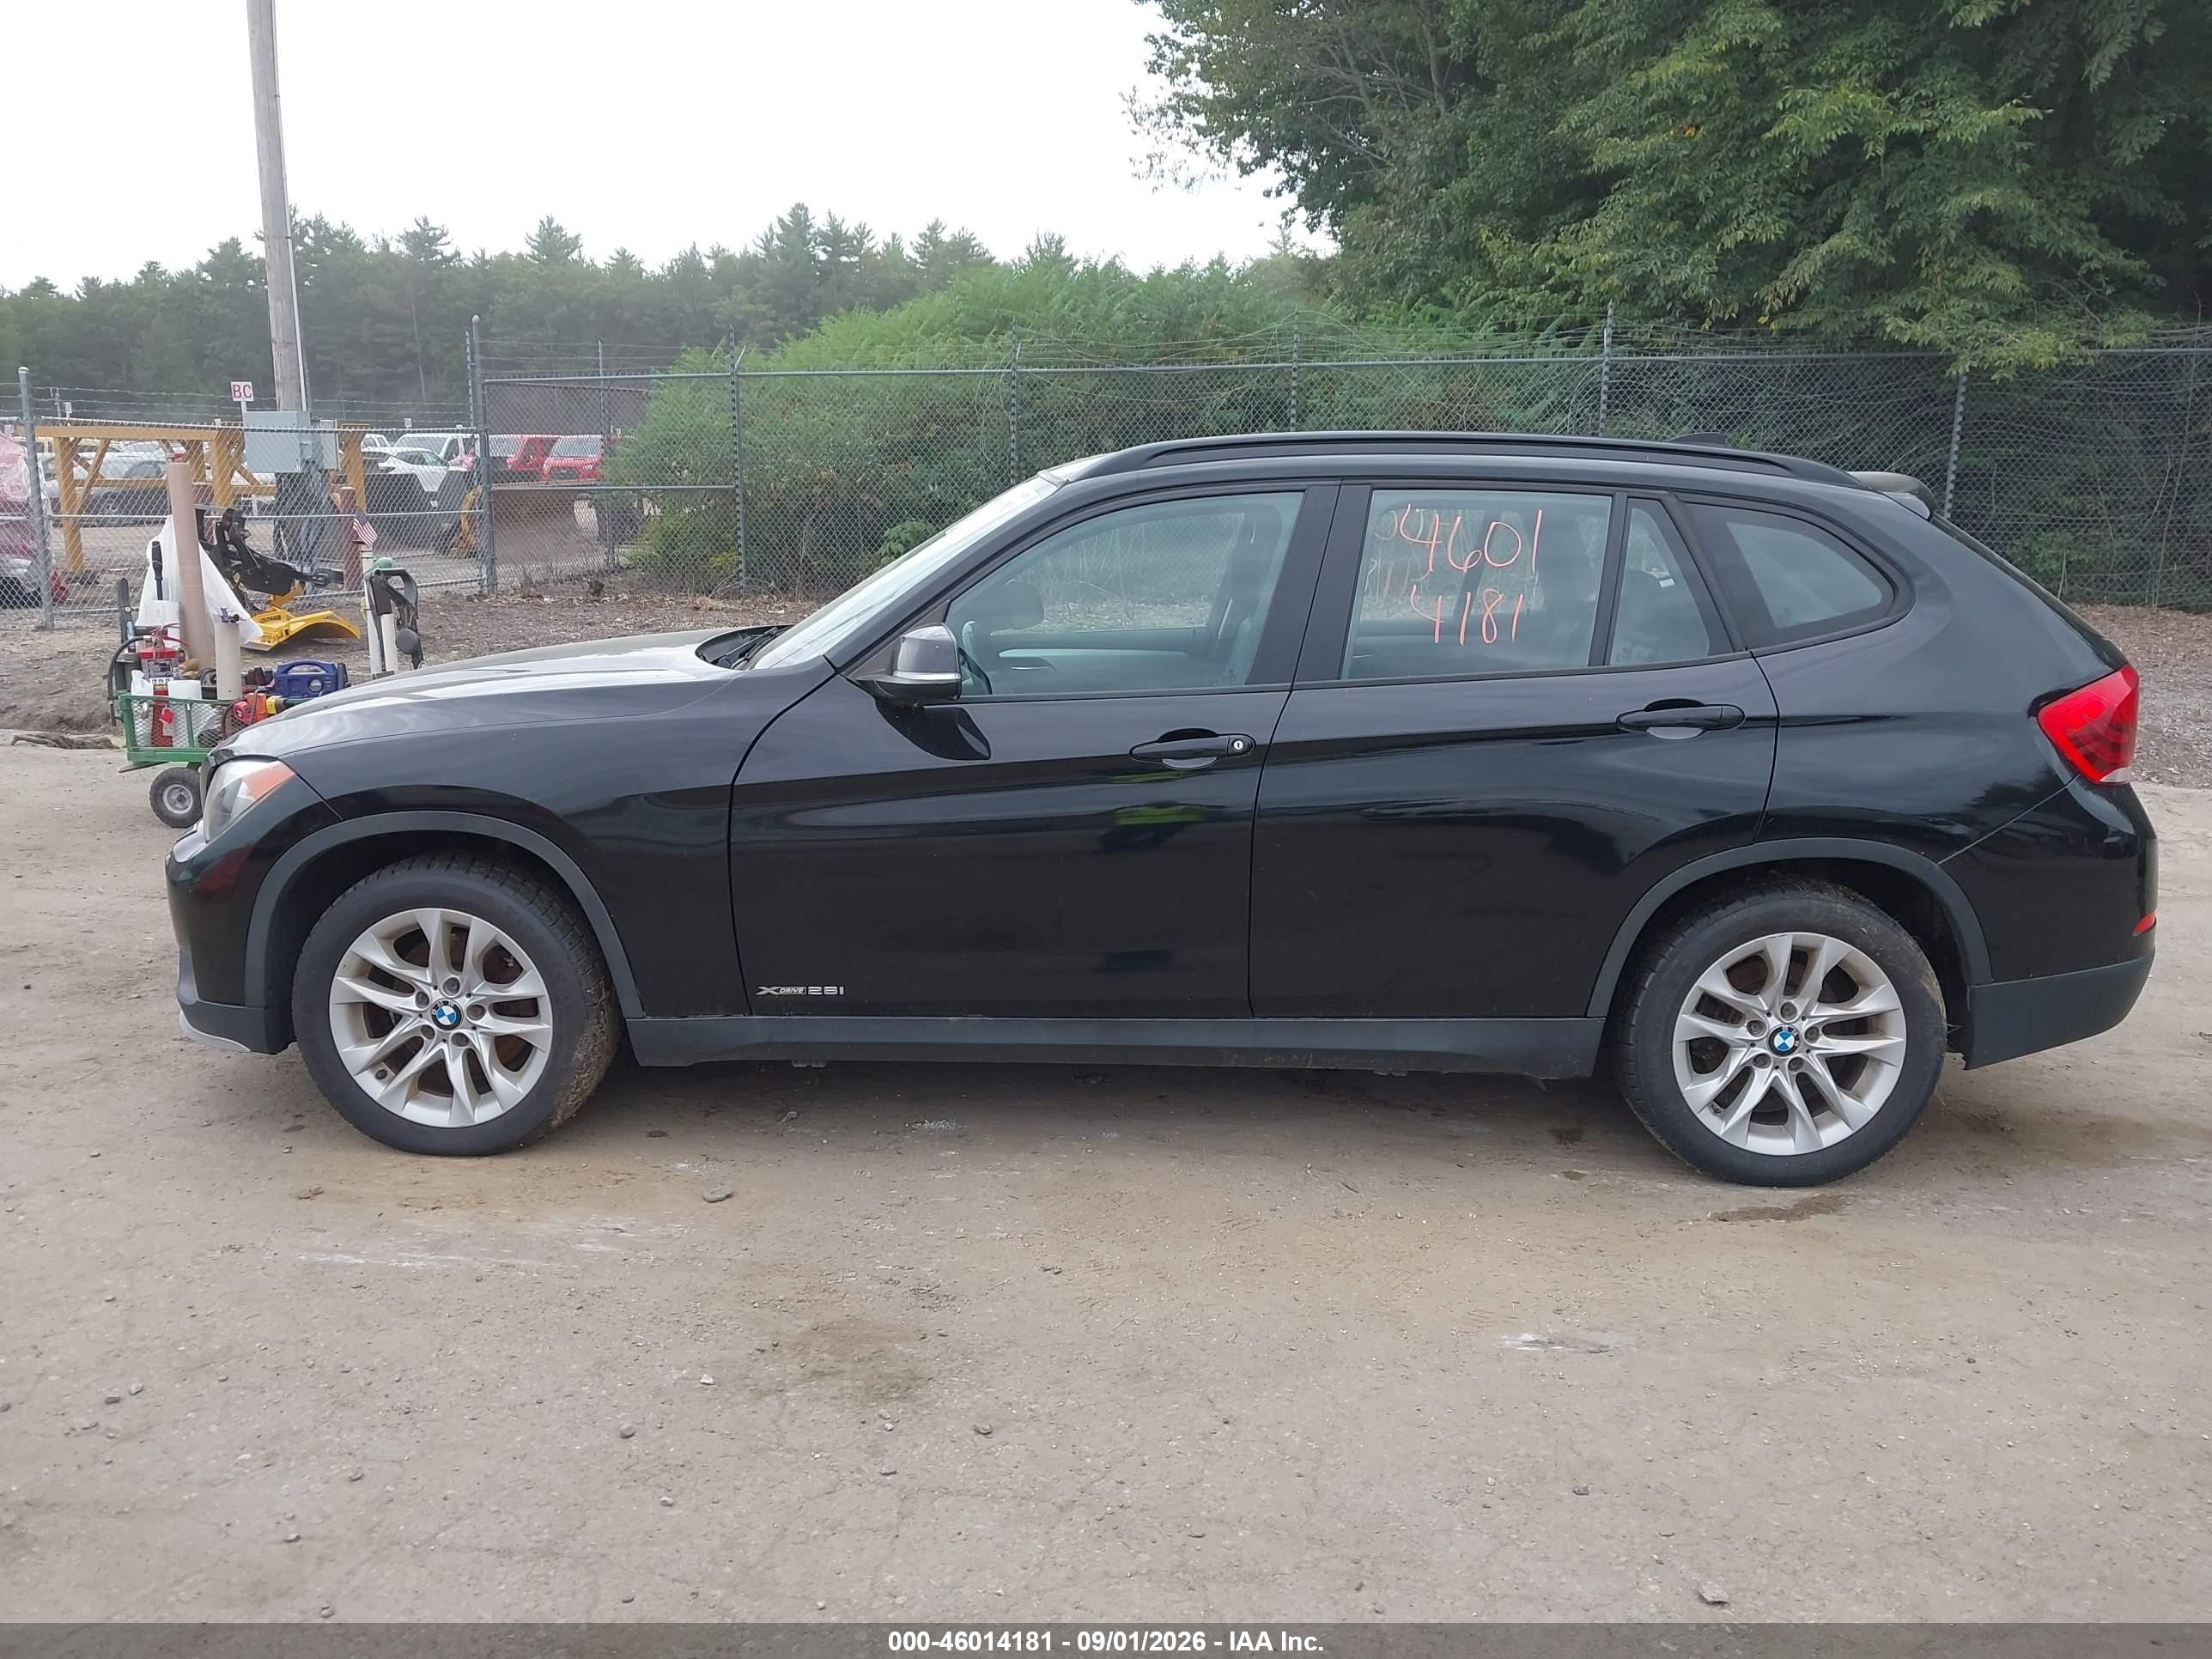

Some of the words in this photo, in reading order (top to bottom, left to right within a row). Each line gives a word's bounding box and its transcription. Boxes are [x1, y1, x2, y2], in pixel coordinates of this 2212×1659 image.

[233, 384, 252, 398] BC
[1399, 502, 1543, 575] 4601
[1409, 583, 1524, 646] 4181
